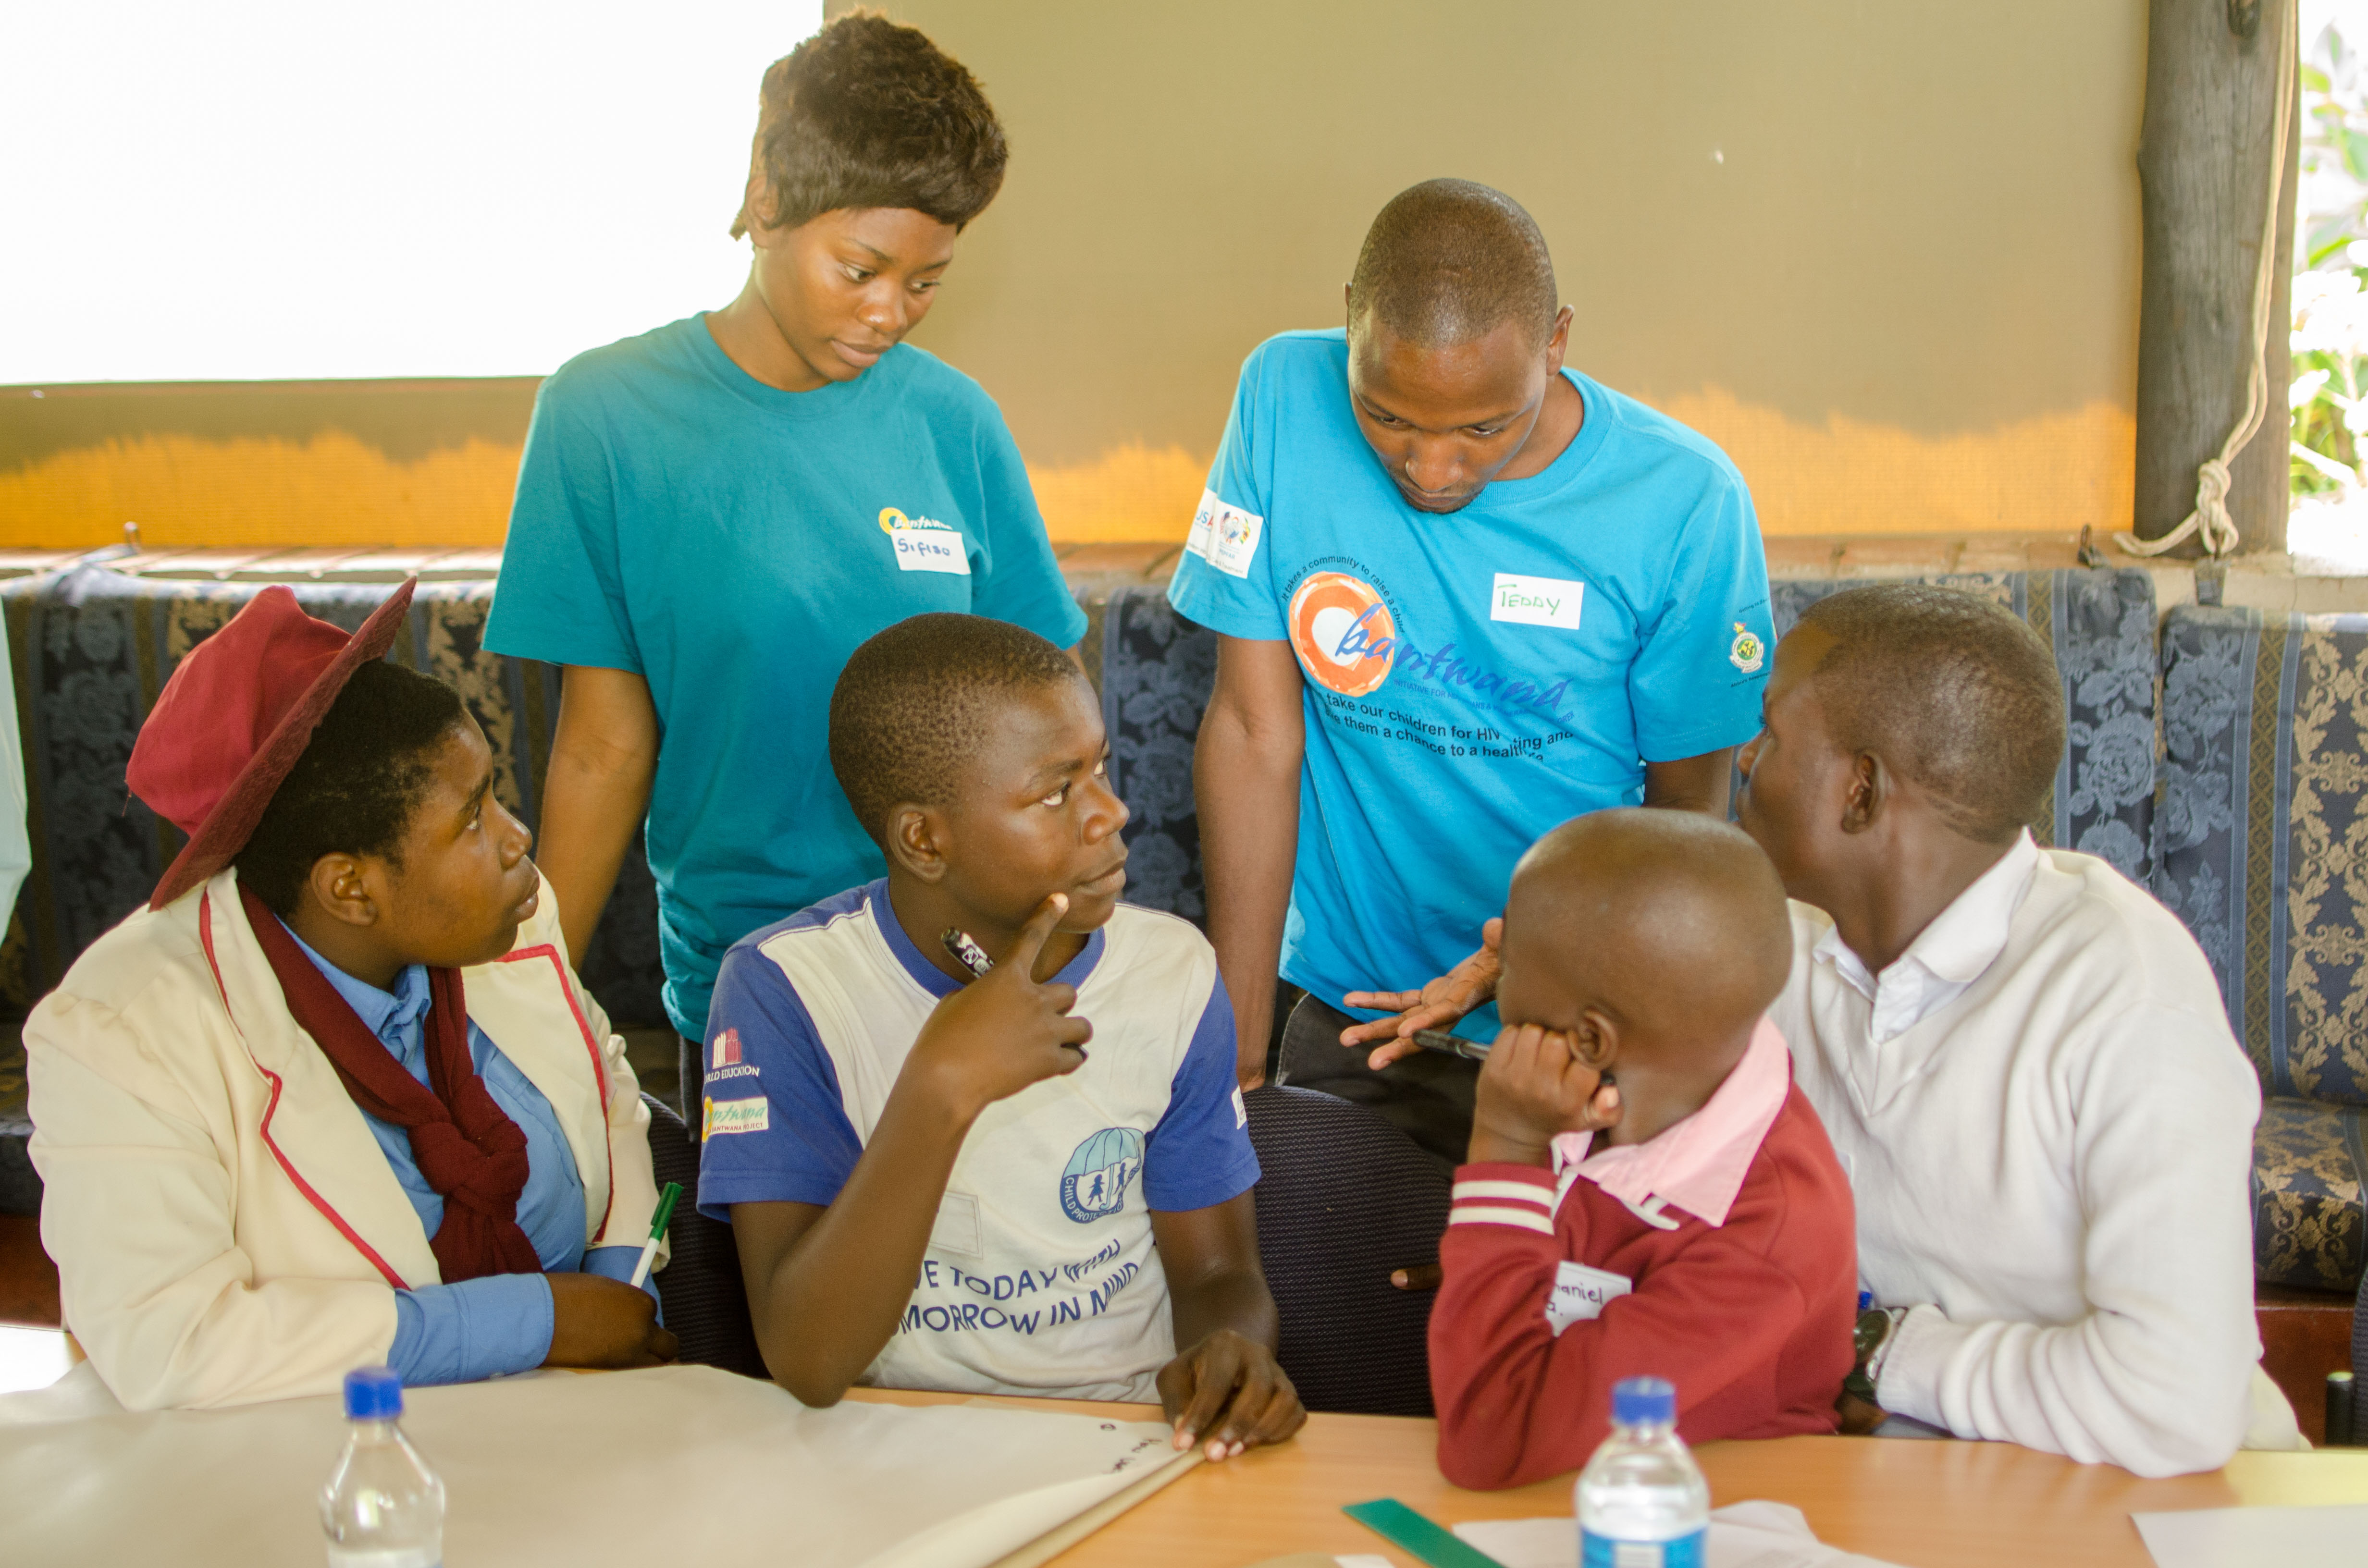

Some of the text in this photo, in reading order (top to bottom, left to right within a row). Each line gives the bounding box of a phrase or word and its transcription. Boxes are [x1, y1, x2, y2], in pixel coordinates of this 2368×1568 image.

[1287, 572, 1302, 593] takes
[1308, 556, 1359, 569] community
[1361, 564, 1369, 575] to
[1370, 574, 1390, 597] raise
[1335, 602, 1574, 710] bantwana
[1326, 693, 1356, 711] take
[1360, 704, 1384, 718] our
[1389, 710, 1446, 737] children
[1451, 725, 1472, 739] for
[1344, 716, 1379, 736] them
[1383, 727, 1392, 738] a
[1396, 728, 1446, 755] chance
[1451, 744, 1465, 757] to
[1469, 746, 1477, 756] a
[721, 1065, 760, 1080] EDUCATION
[1064, 1177, 1076, 1210] CHILD
[950, 1266, 1058, 1301] TODAY
[1049, 1297, 1081, 1326] IN
[1090, 1262, 1139, 1316] MIND
